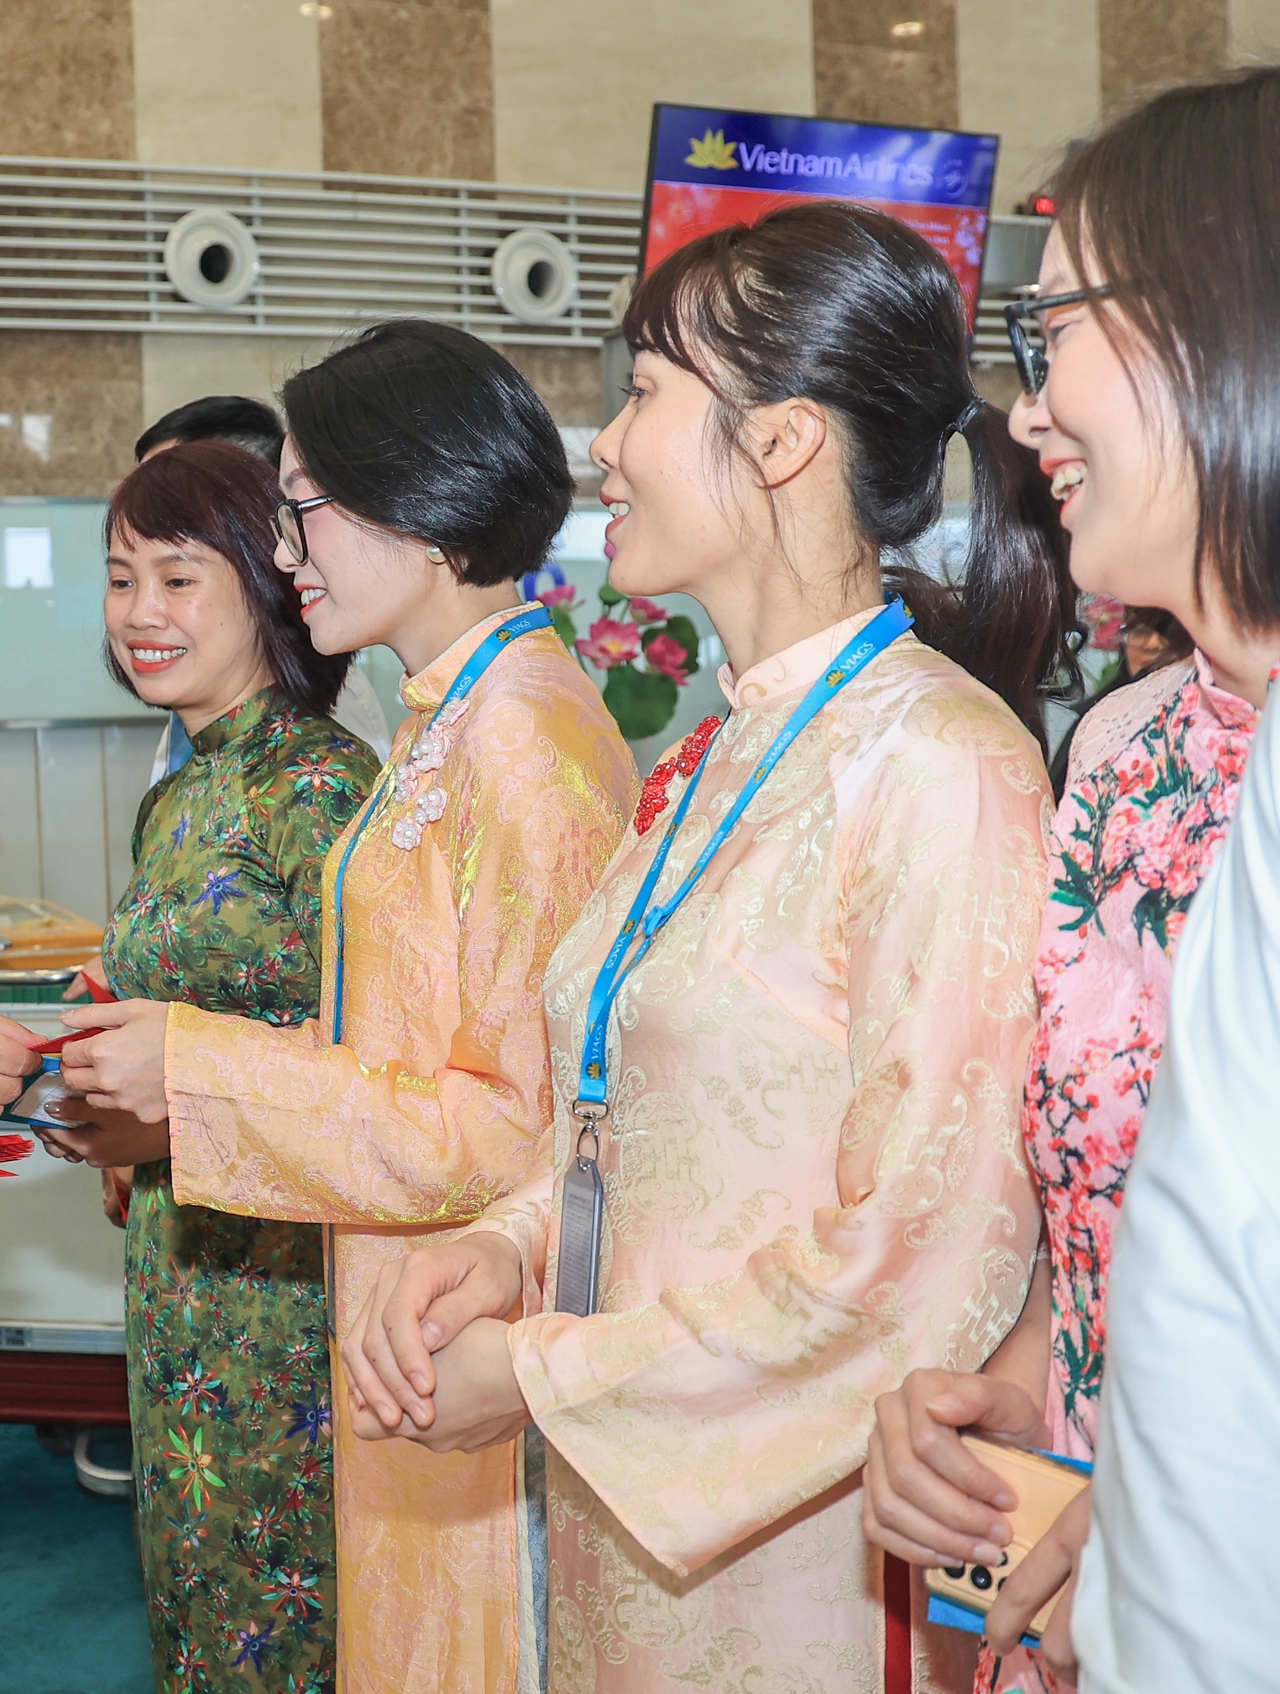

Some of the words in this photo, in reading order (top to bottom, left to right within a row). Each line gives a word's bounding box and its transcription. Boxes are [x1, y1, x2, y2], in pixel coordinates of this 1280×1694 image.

[738, 141, 841, 179] Vietnam
[508, 619, 532, 633] VIAGS
[840, 640, 874, 671] VIAGS
[449, 674, 472, 701] VIAGS
[604, 936, 627, 970] VIAGS
[591, 1024, 603, 1061] VIAGS
